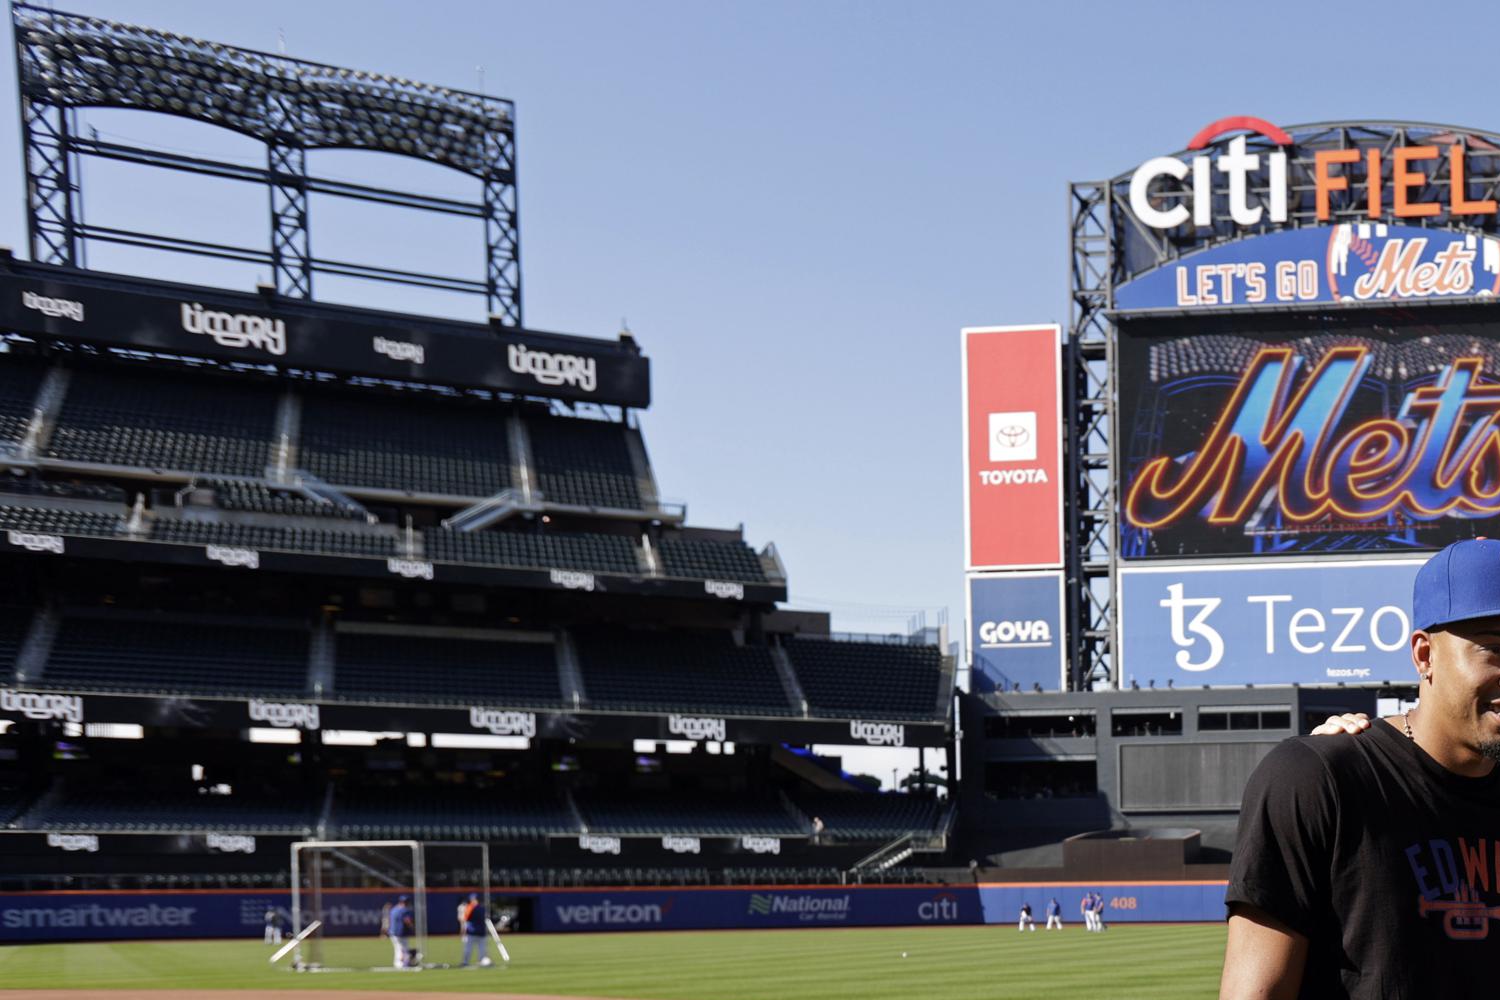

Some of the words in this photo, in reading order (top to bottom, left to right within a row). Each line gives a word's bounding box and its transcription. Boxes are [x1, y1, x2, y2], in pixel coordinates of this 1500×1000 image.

[1129, 132, 1290, 229] citi
[1176, 262, 1266, 306] LET'S
[1275, 260, 1319, 300] GO
[1354, 238, 1478, 300] Mets
[979, 469, 1048, 485] TOYOTA
[980, 620, 1050, 643] GOYA
[1247, 594, 1411, 655] Tezo
[556, 900, 661, 923] verizon
[772, 895, 849, 912] National
[918, 897, 957, 920] citi
[1110, 897, 1137, 909] 408
[2, 904, 197, 928] smartwater
